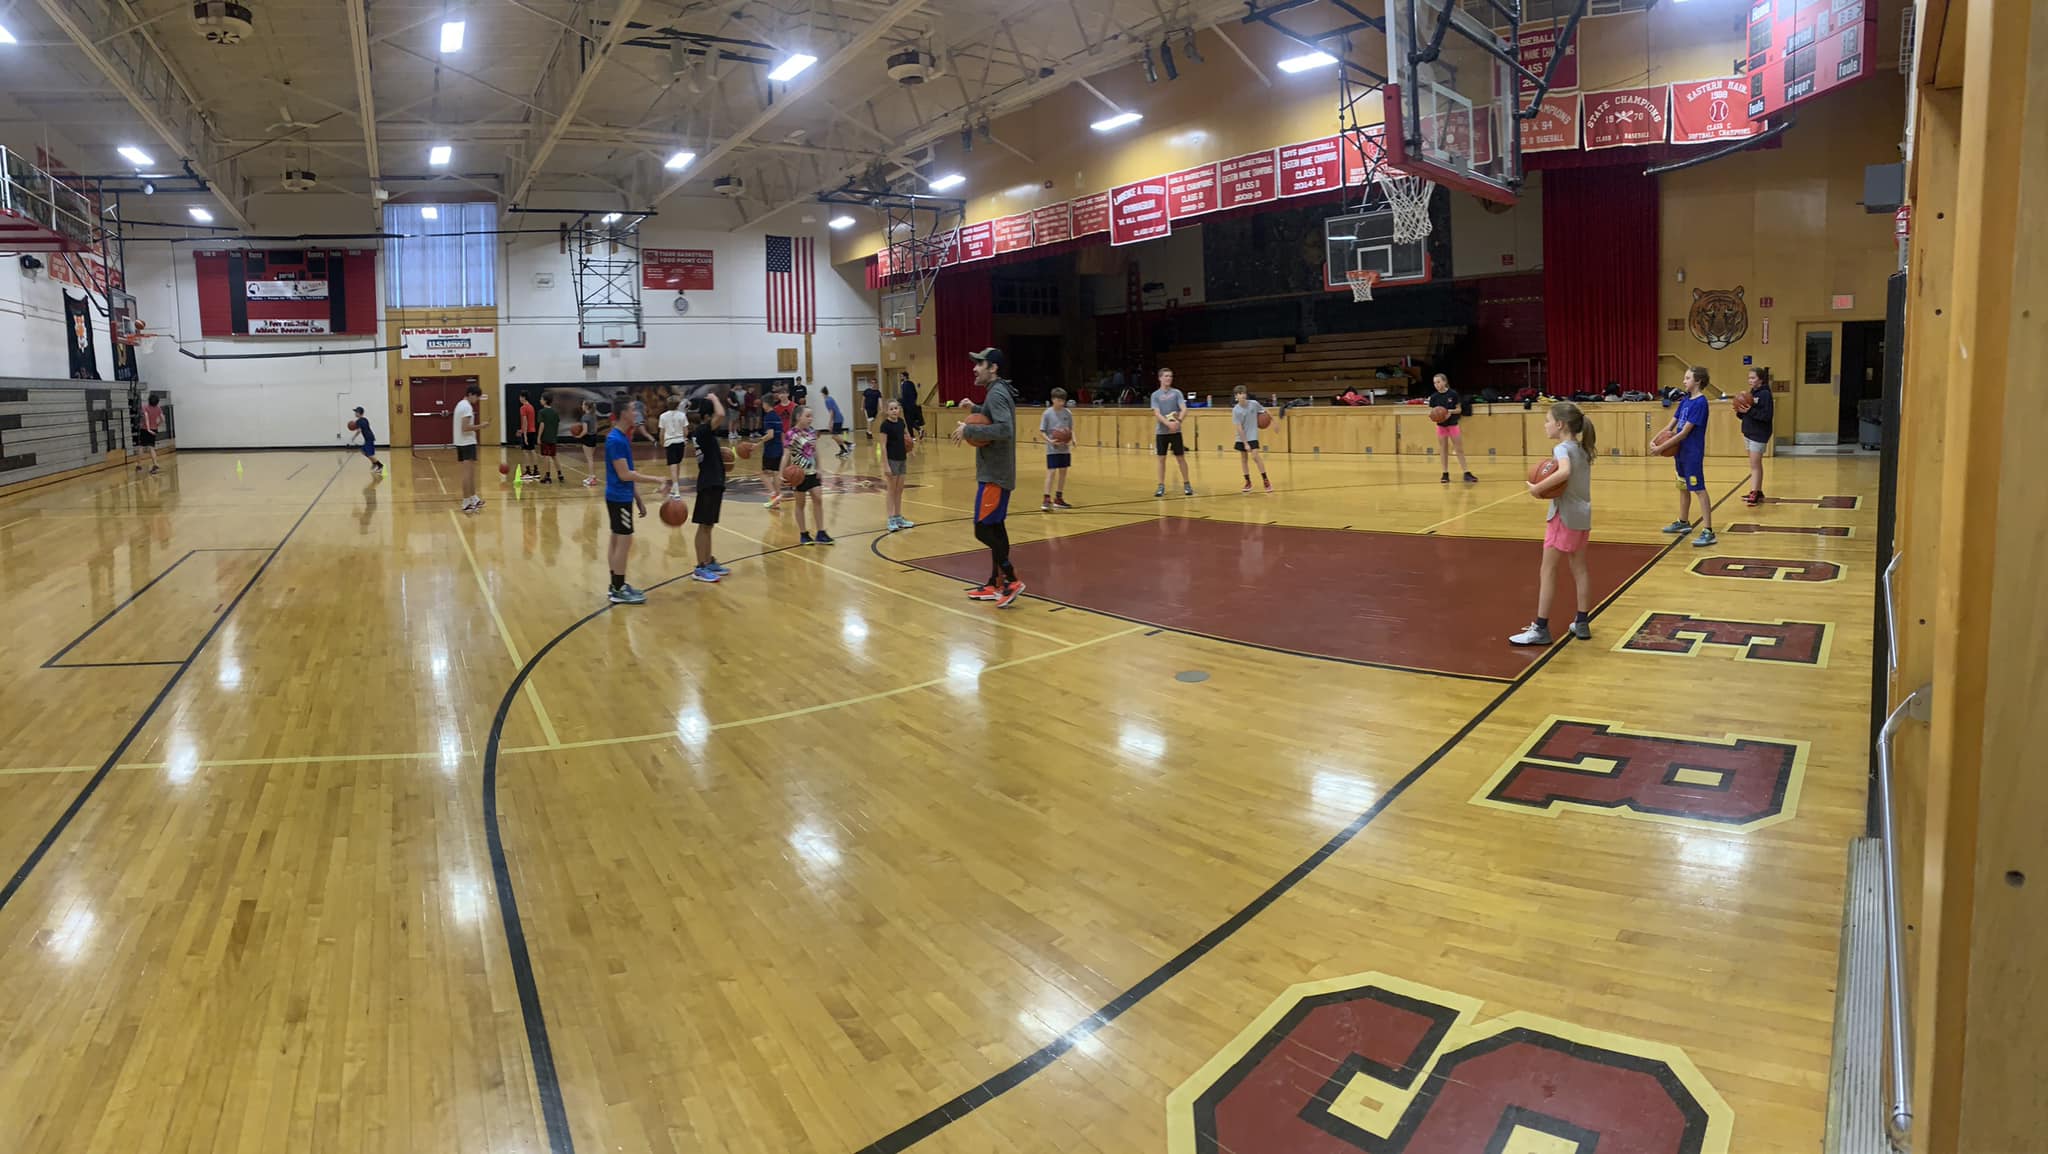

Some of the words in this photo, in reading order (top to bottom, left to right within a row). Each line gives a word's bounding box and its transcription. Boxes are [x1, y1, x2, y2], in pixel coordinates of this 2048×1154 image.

[1839, 59, 1858, 77] fouls
[1686, 80, 1722, 102] EASTERN
[1587, 100, 1610, 128] STATE
[1615, 95, 1662, 122] CHAMPIONS
[1296, 169, 1316, 179] CLASS
